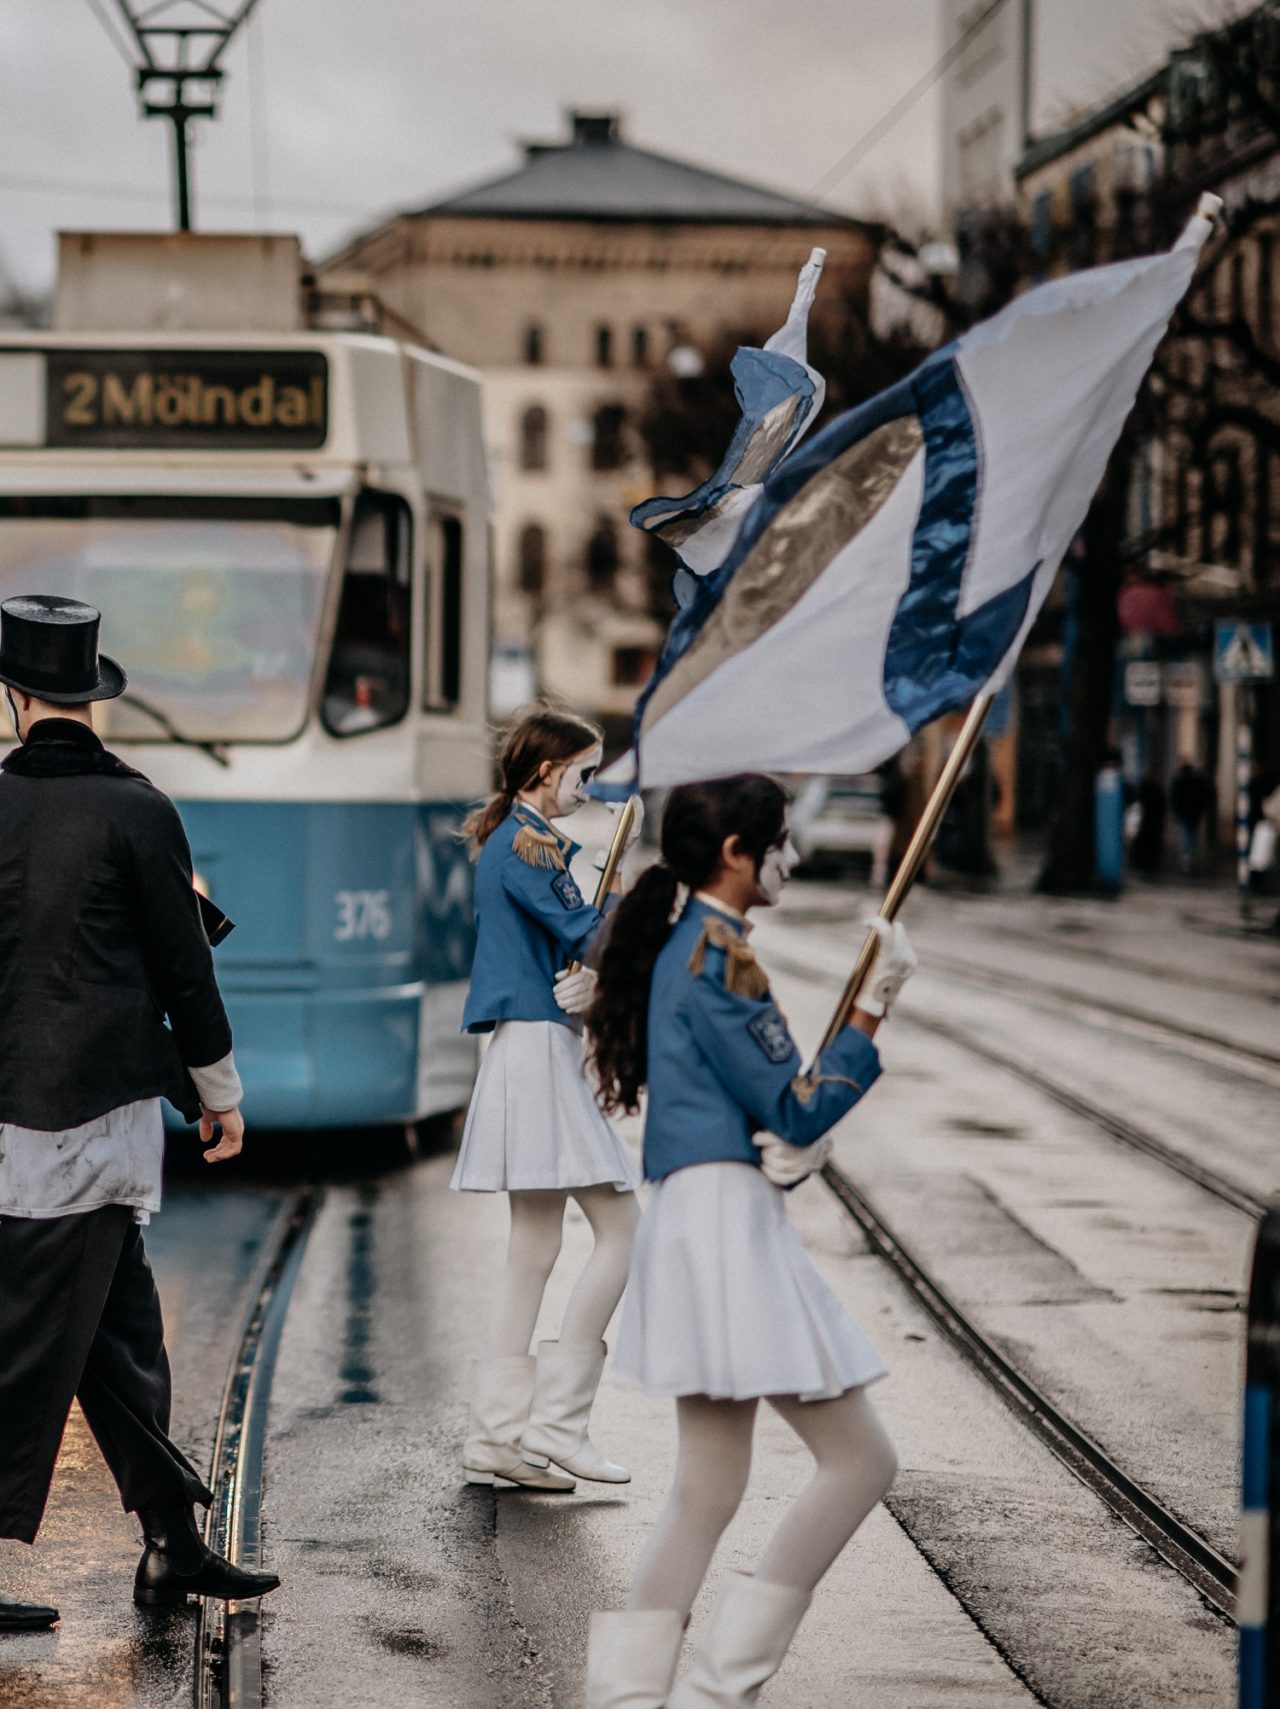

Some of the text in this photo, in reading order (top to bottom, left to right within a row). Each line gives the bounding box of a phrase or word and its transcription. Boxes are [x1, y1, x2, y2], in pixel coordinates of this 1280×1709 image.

[62, 371, 324, 427] 2 Mölndal
[333, 888, 392, 941] 376
